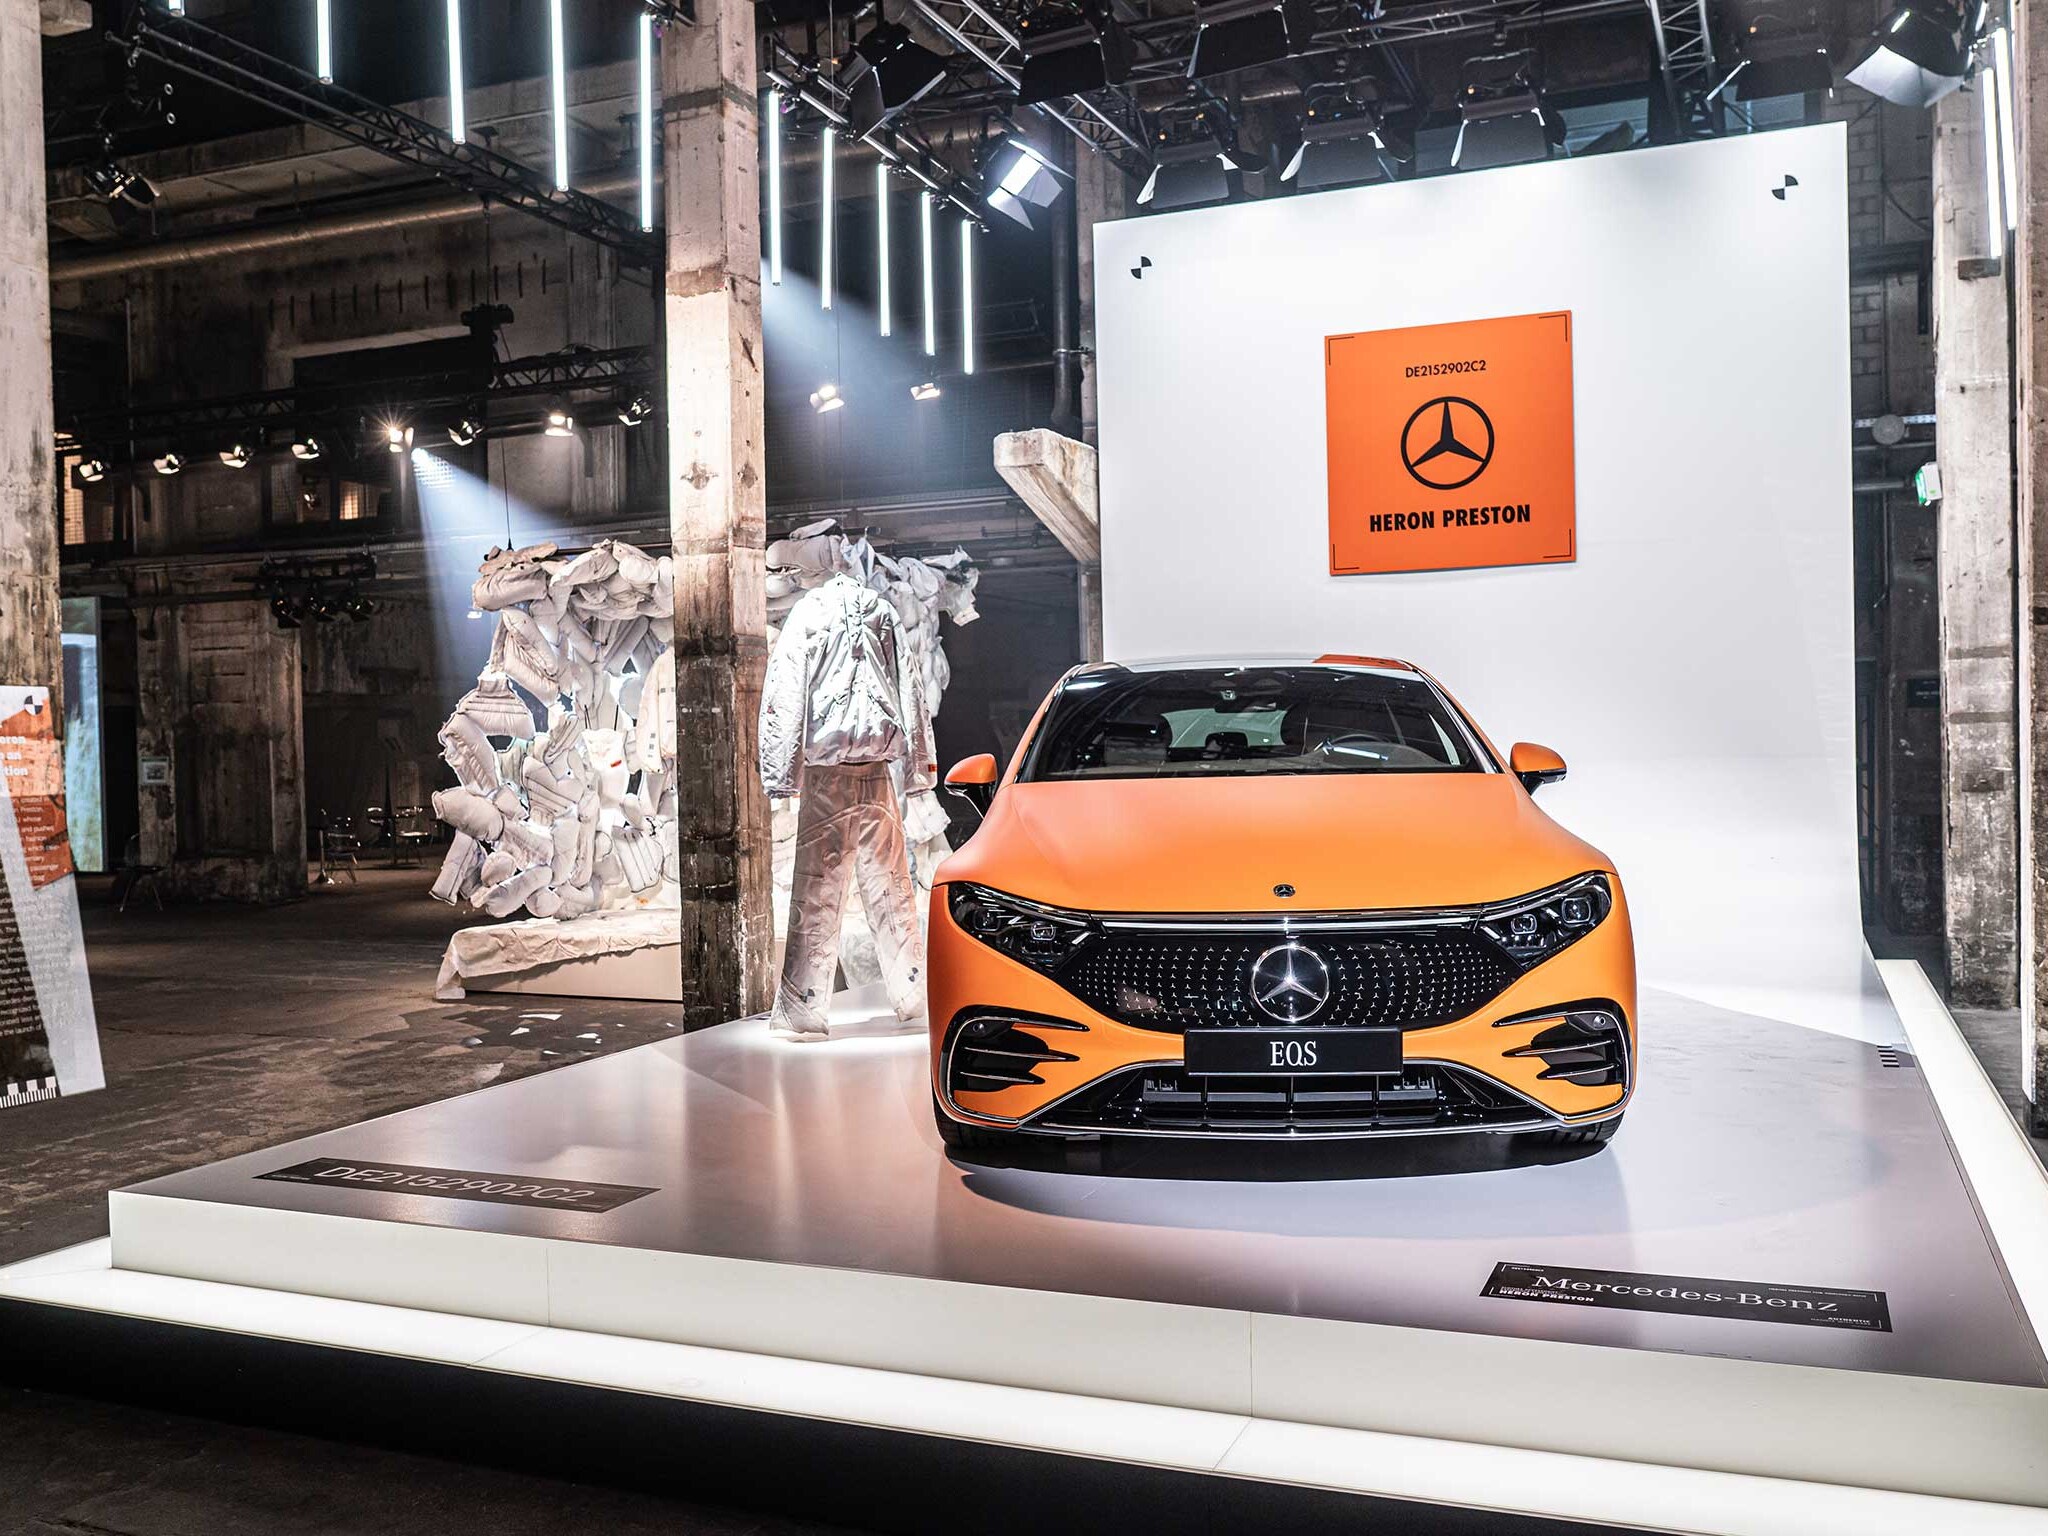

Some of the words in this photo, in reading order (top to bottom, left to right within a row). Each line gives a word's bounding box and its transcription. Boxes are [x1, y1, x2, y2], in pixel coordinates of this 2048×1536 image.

[1405, 359, 1487, 378] DE2152902C2
[1370, 511, 1435, 532] HERON
[1442, 504, 1531, 528] PRESTON
[1269, 1041, 1317, 1067] EQS
[314, 1166, 595, 1202] DE2152902C2
[1499, 1289, 1538, 1297] HERON
[1541, 1292, 1594, 1302] PRESTON
[1531, 1275, 1839, 1312] Mercedes-Benz
